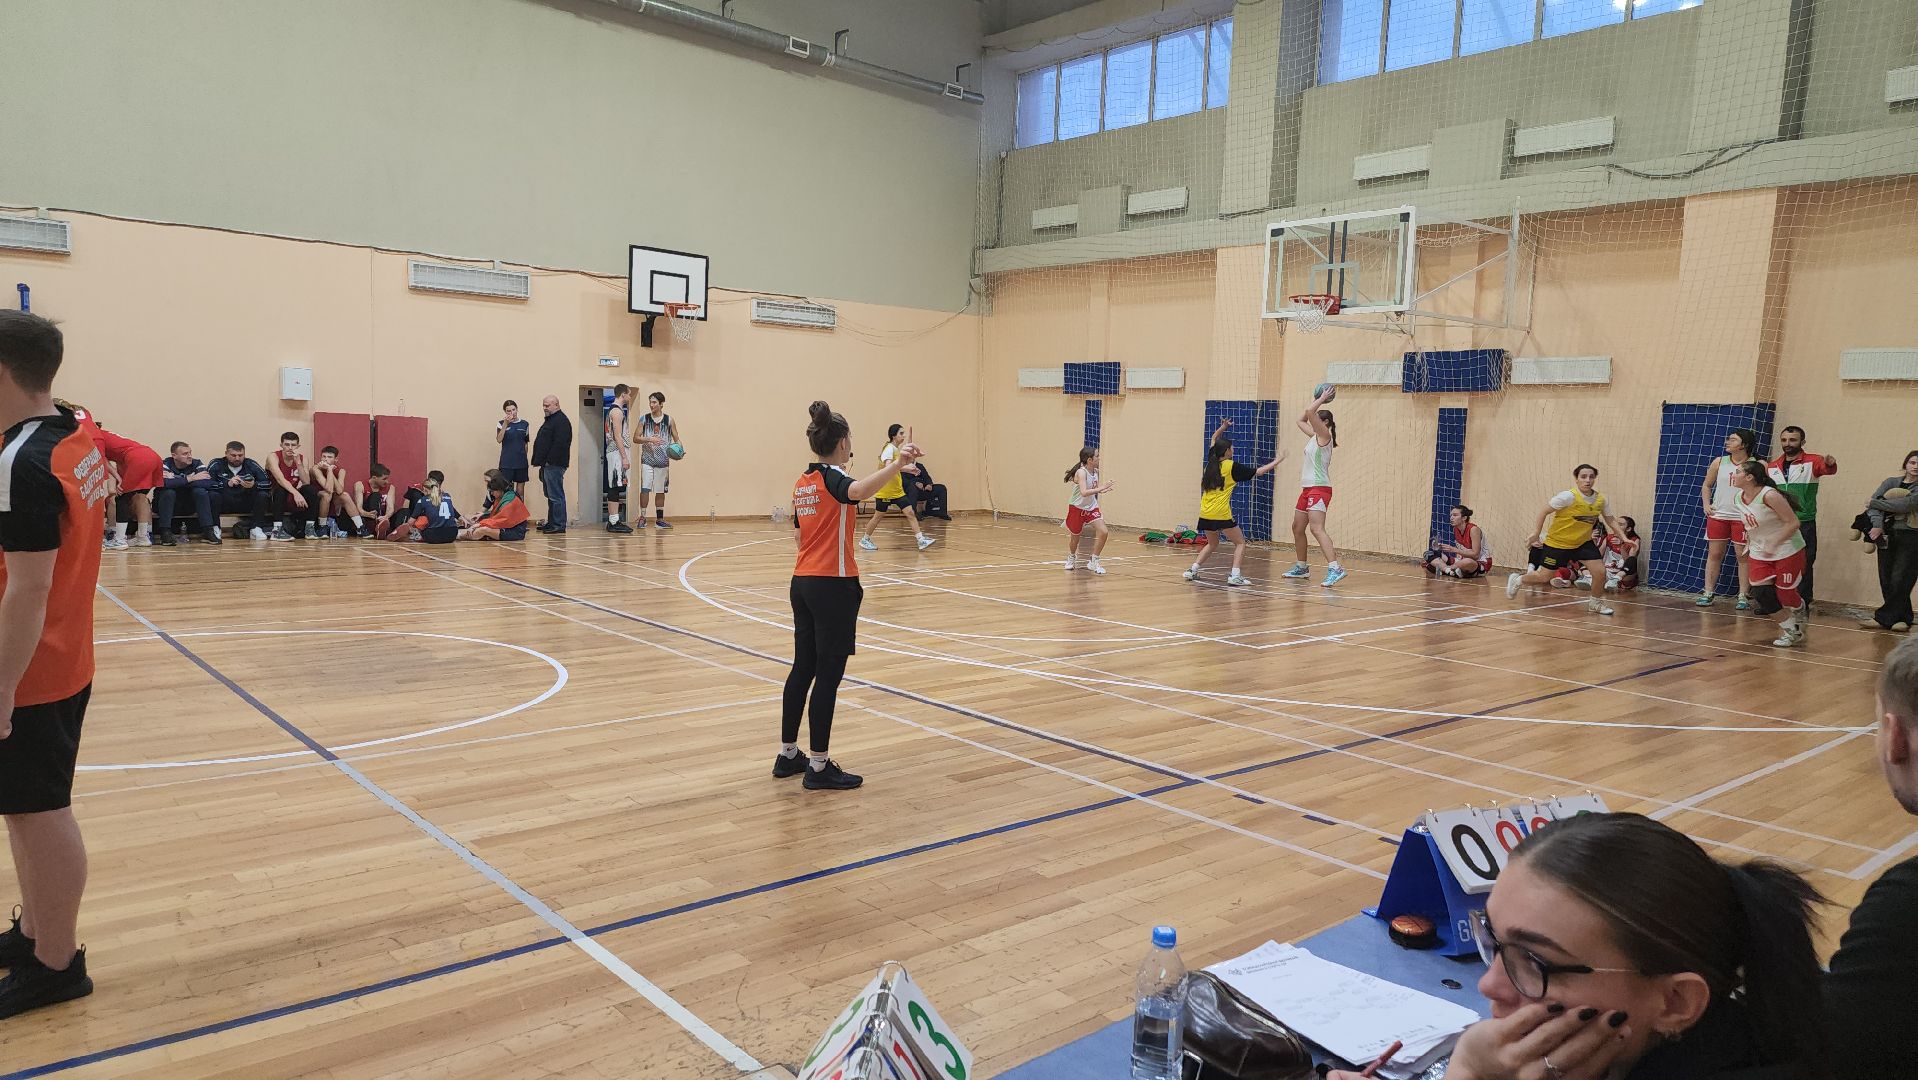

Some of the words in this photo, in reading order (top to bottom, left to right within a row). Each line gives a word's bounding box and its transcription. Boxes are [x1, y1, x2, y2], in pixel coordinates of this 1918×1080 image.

[439, 501, 451, 520] 4
[1783, 573, 1792, 584] 10
[1451, 824, 1500, 881] 0
[907, 1000, 967, 1080] 3
